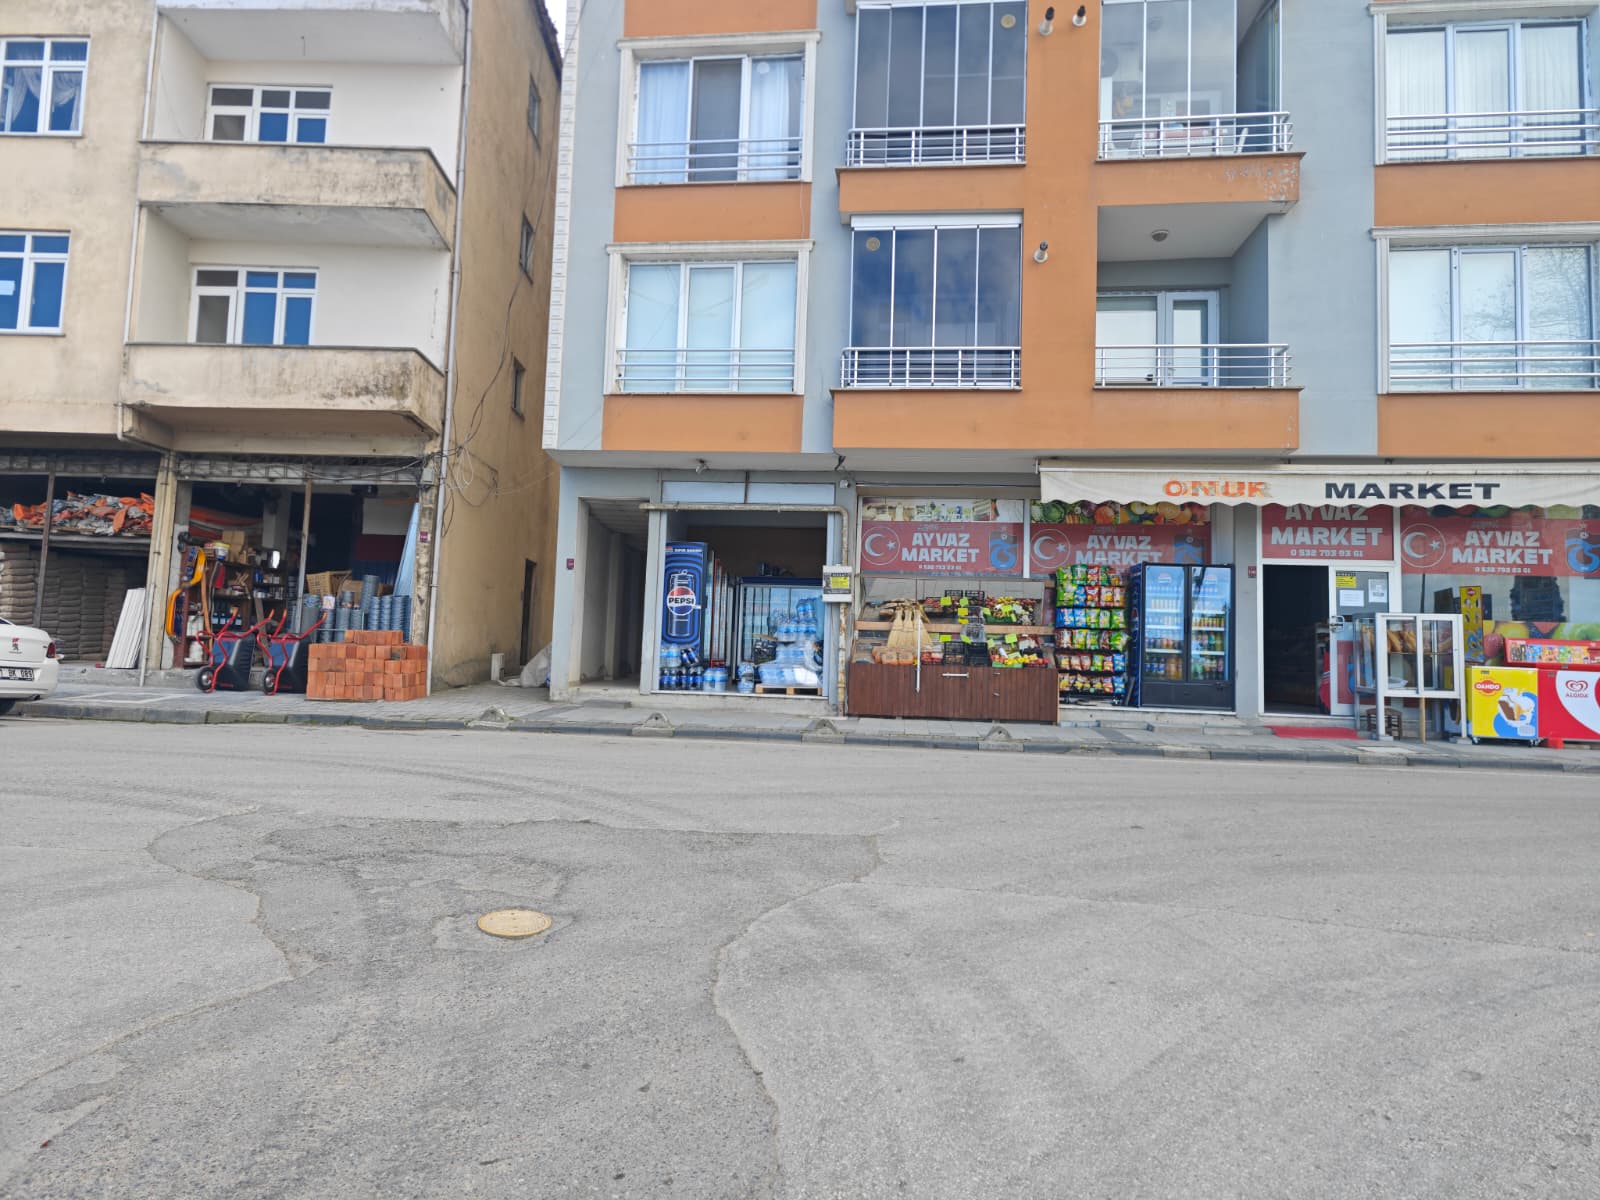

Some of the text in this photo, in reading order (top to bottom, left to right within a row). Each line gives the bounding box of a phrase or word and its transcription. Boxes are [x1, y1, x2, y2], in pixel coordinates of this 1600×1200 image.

[1325, 482, 1500, 500] MARKET
[1284, 504, 1369, 521] AYVAZ
[912, 532, 971, 547] AYVAZ
[1086, 534, 1152, 550] AYVAZ
[1271, 526, 1383, 546] MARKET
[1464, 530, 1541, 547] AYVAZ
[901, 547, 980, 563] MARKET
[1075, 550, 1163, 566] MARKET
[1451, 547, 1554, 565] MARKET
